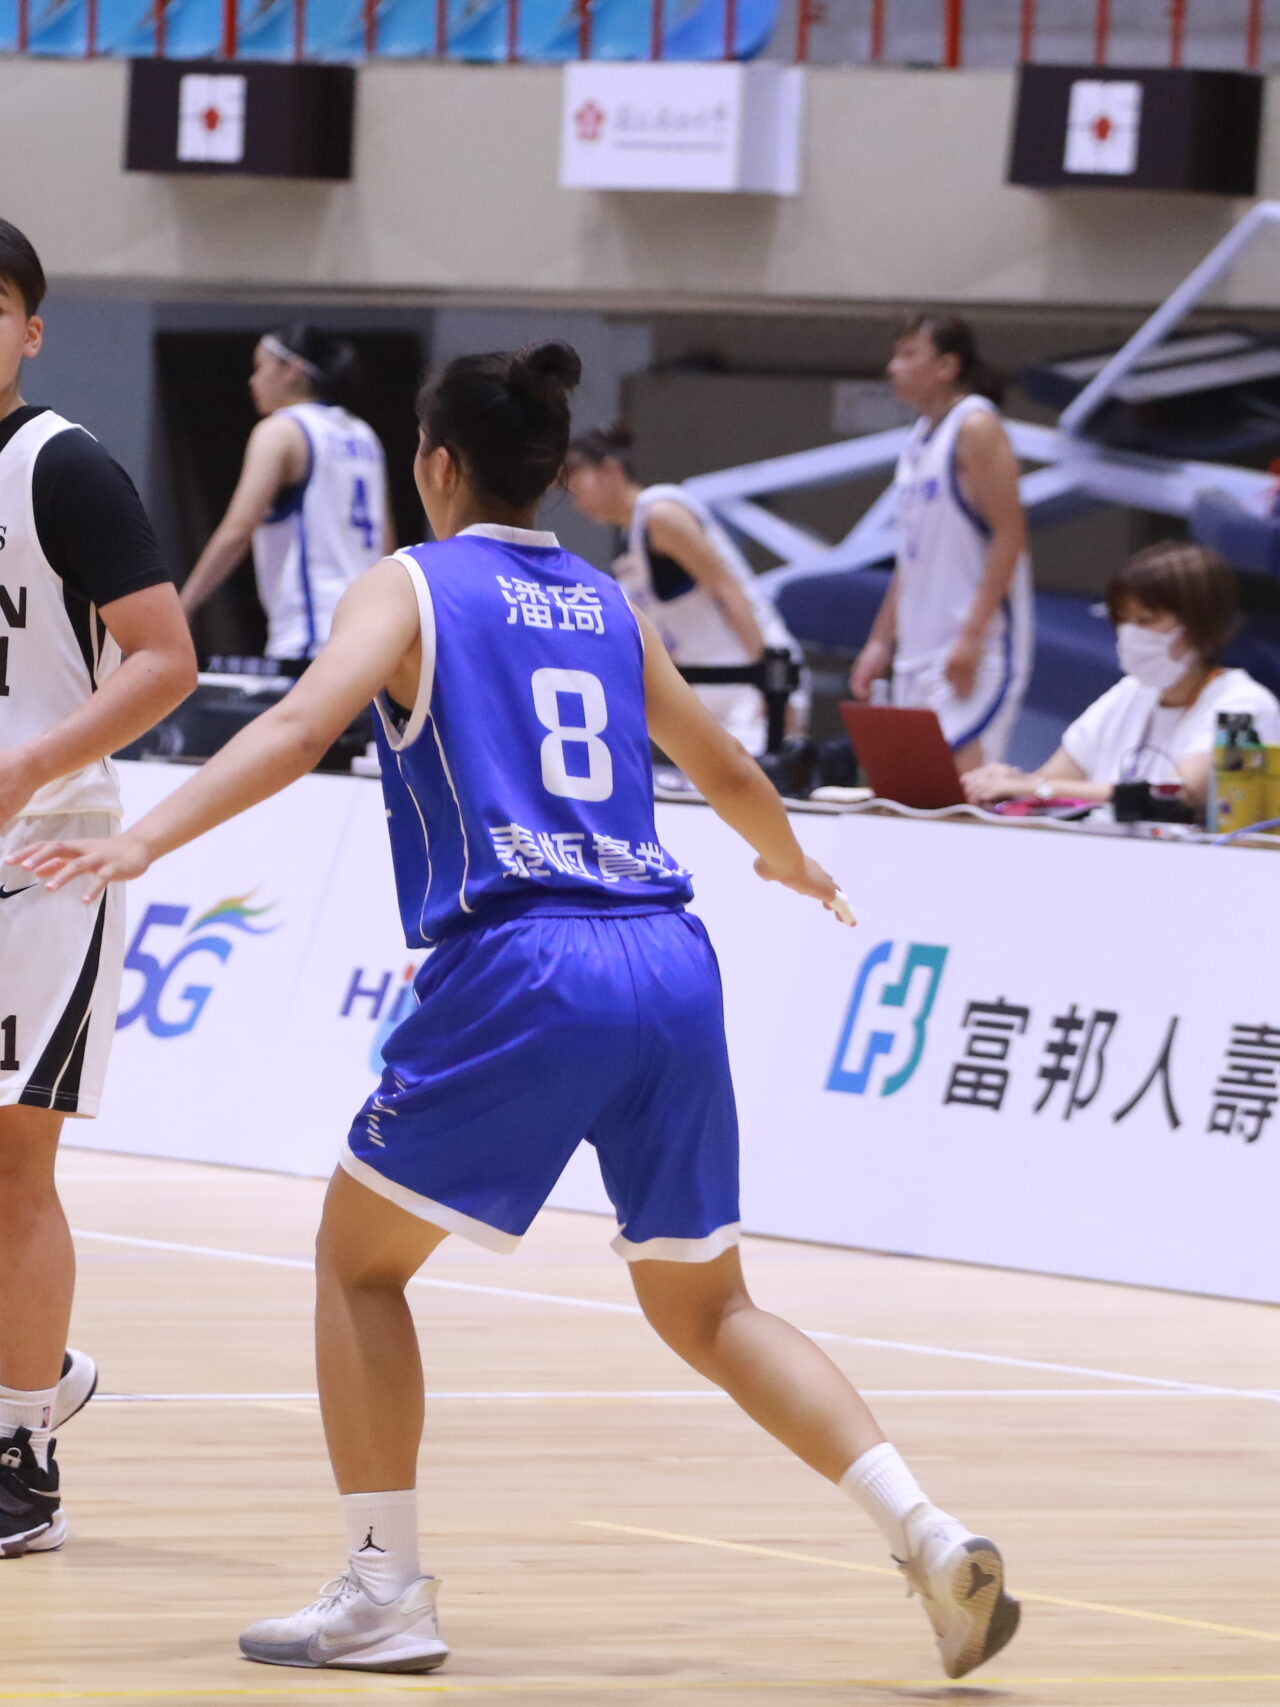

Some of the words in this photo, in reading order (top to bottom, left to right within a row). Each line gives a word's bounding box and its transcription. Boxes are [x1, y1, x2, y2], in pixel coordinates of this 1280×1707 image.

[349, 478, 373, 549] 4
[495, 574, 605, 635] 潘琦
[530, 667, 614, 803] 8
[115, 903, 234, 1039] 5G
[941, 996, 1280, 1144] 富邦人壽
